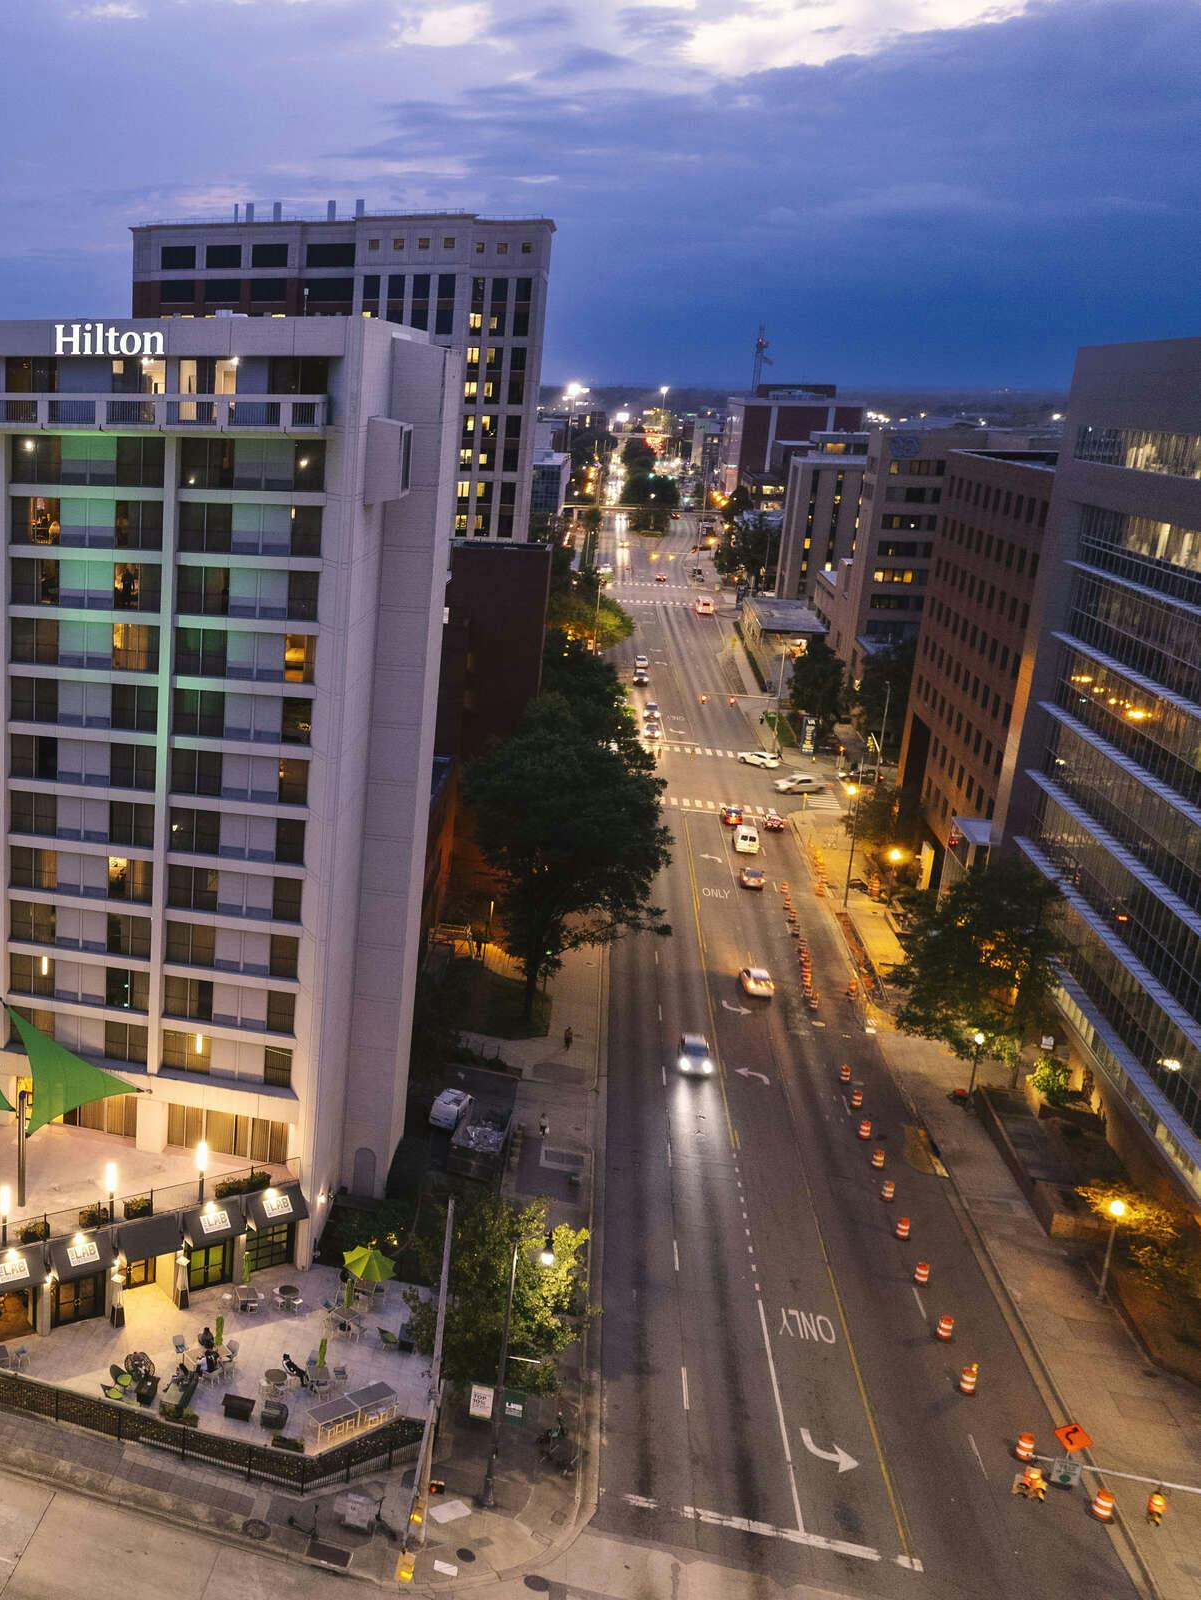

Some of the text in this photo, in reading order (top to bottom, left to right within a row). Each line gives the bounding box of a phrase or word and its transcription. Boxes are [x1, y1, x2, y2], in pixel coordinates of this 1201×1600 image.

[54, 323, 165, 355] Hilton
[702, 887, 731, 899] ONLY
[270, 1198, 290, 1212] LAB
[207, 1213, 229, 1227] LAB
[74, 1244, 97, 1259] LAB
[3, 1262, 27, 1276] LAB
[779, 1307, 836, 1344] ONLY
